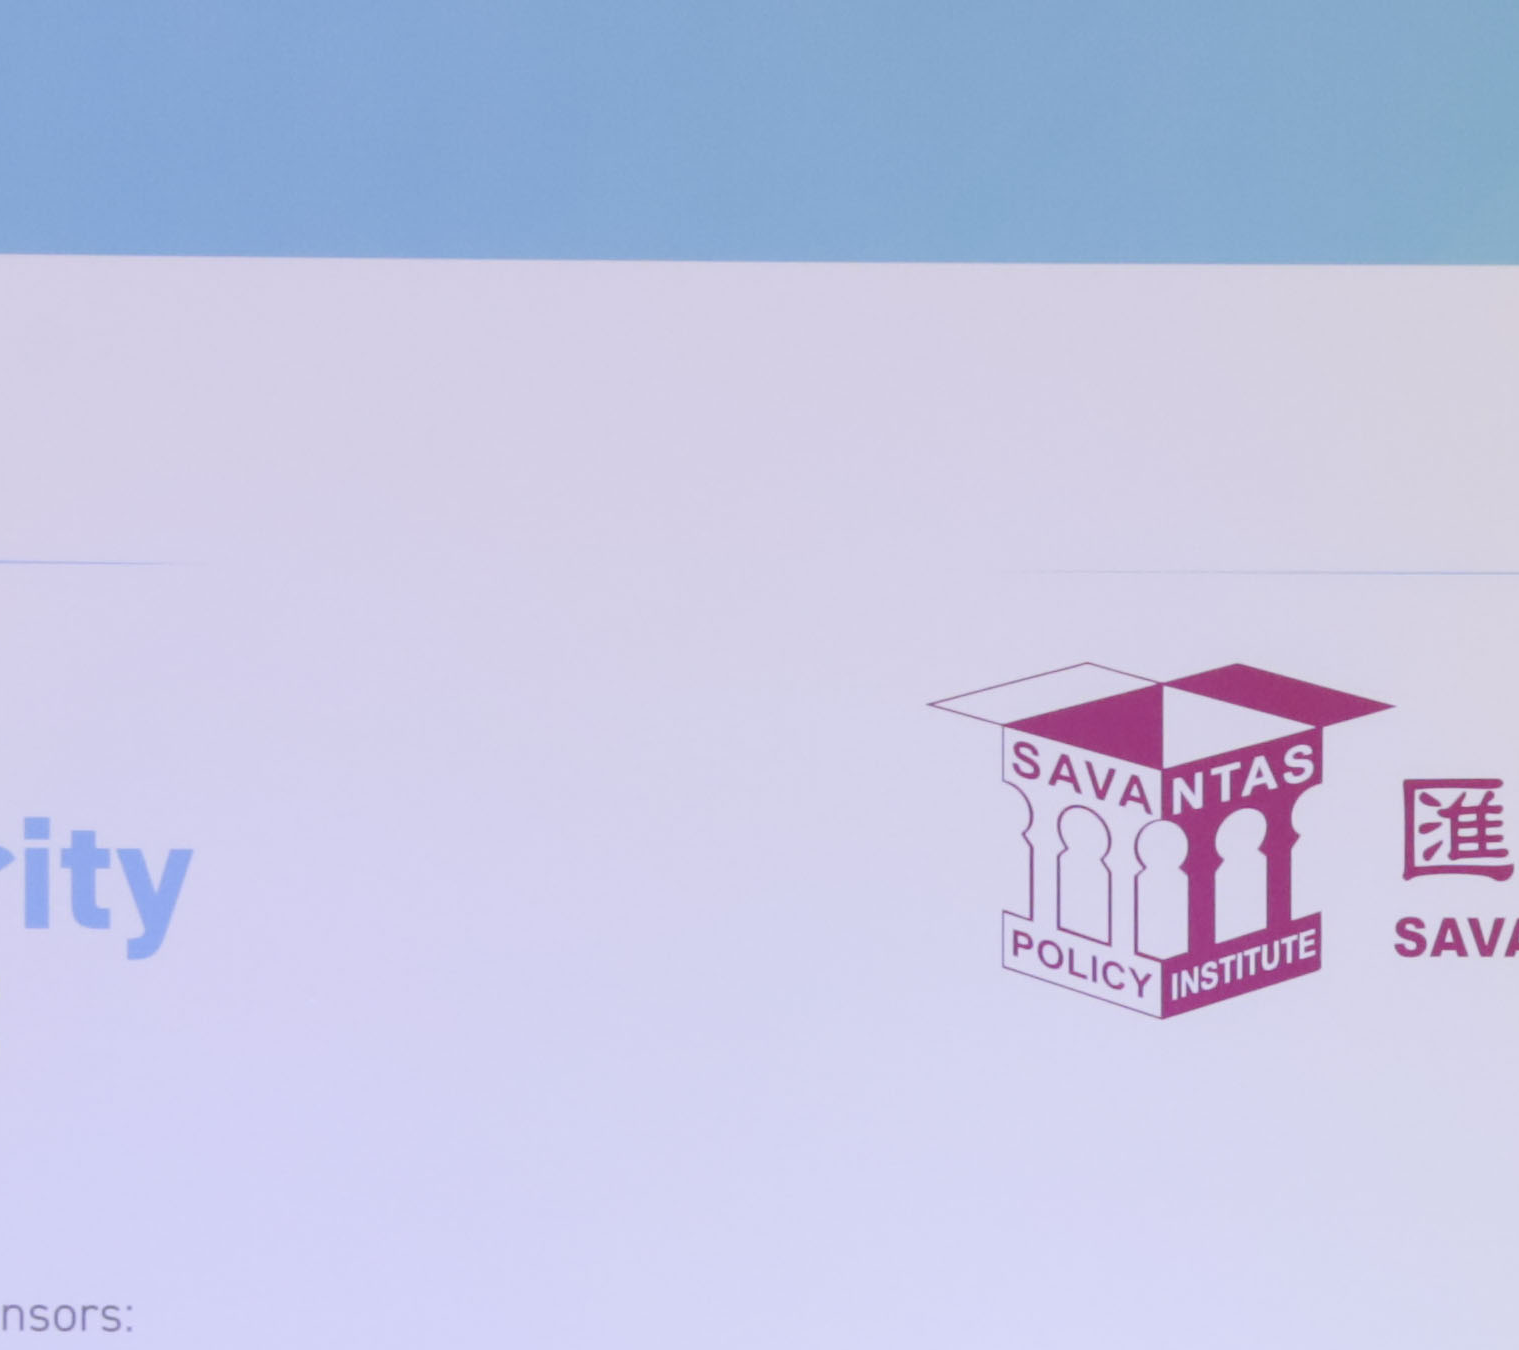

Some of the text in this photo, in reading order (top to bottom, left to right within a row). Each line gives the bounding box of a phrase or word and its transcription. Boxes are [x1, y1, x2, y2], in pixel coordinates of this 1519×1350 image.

[1013, 741, 1314, 815] SAVANTAS
[1013, 929, 1152, 998] POLICY
[1171, 928, 1317, 1001] INSTITUTE
